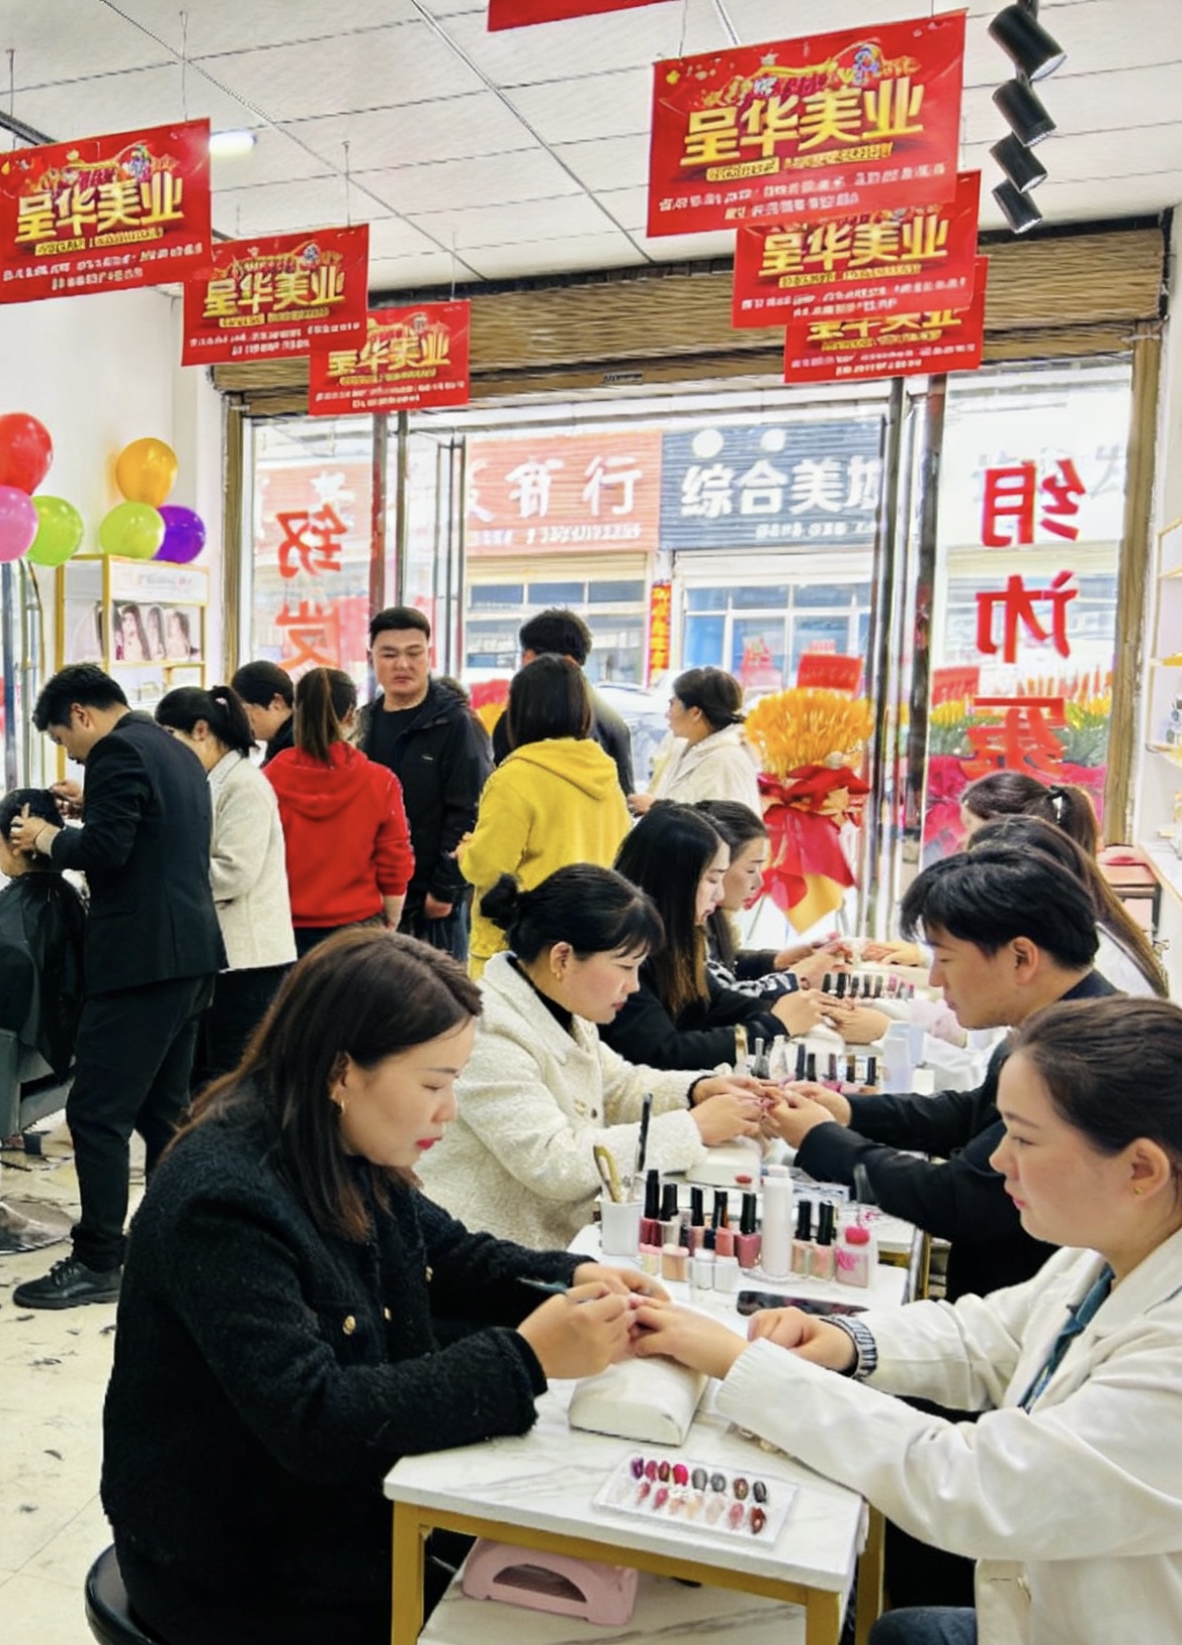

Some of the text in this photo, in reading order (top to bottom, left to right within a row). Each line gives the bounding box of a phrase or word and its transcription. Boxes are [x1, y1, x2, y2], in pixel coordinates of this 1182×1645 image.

[679, 76, 924, 166] 呈华美业
[14, 170, 184, 243] 呈华美业
[758, 214, 949, 277] 呈华美业
[203, 265, 346, 318] 呈华美业
